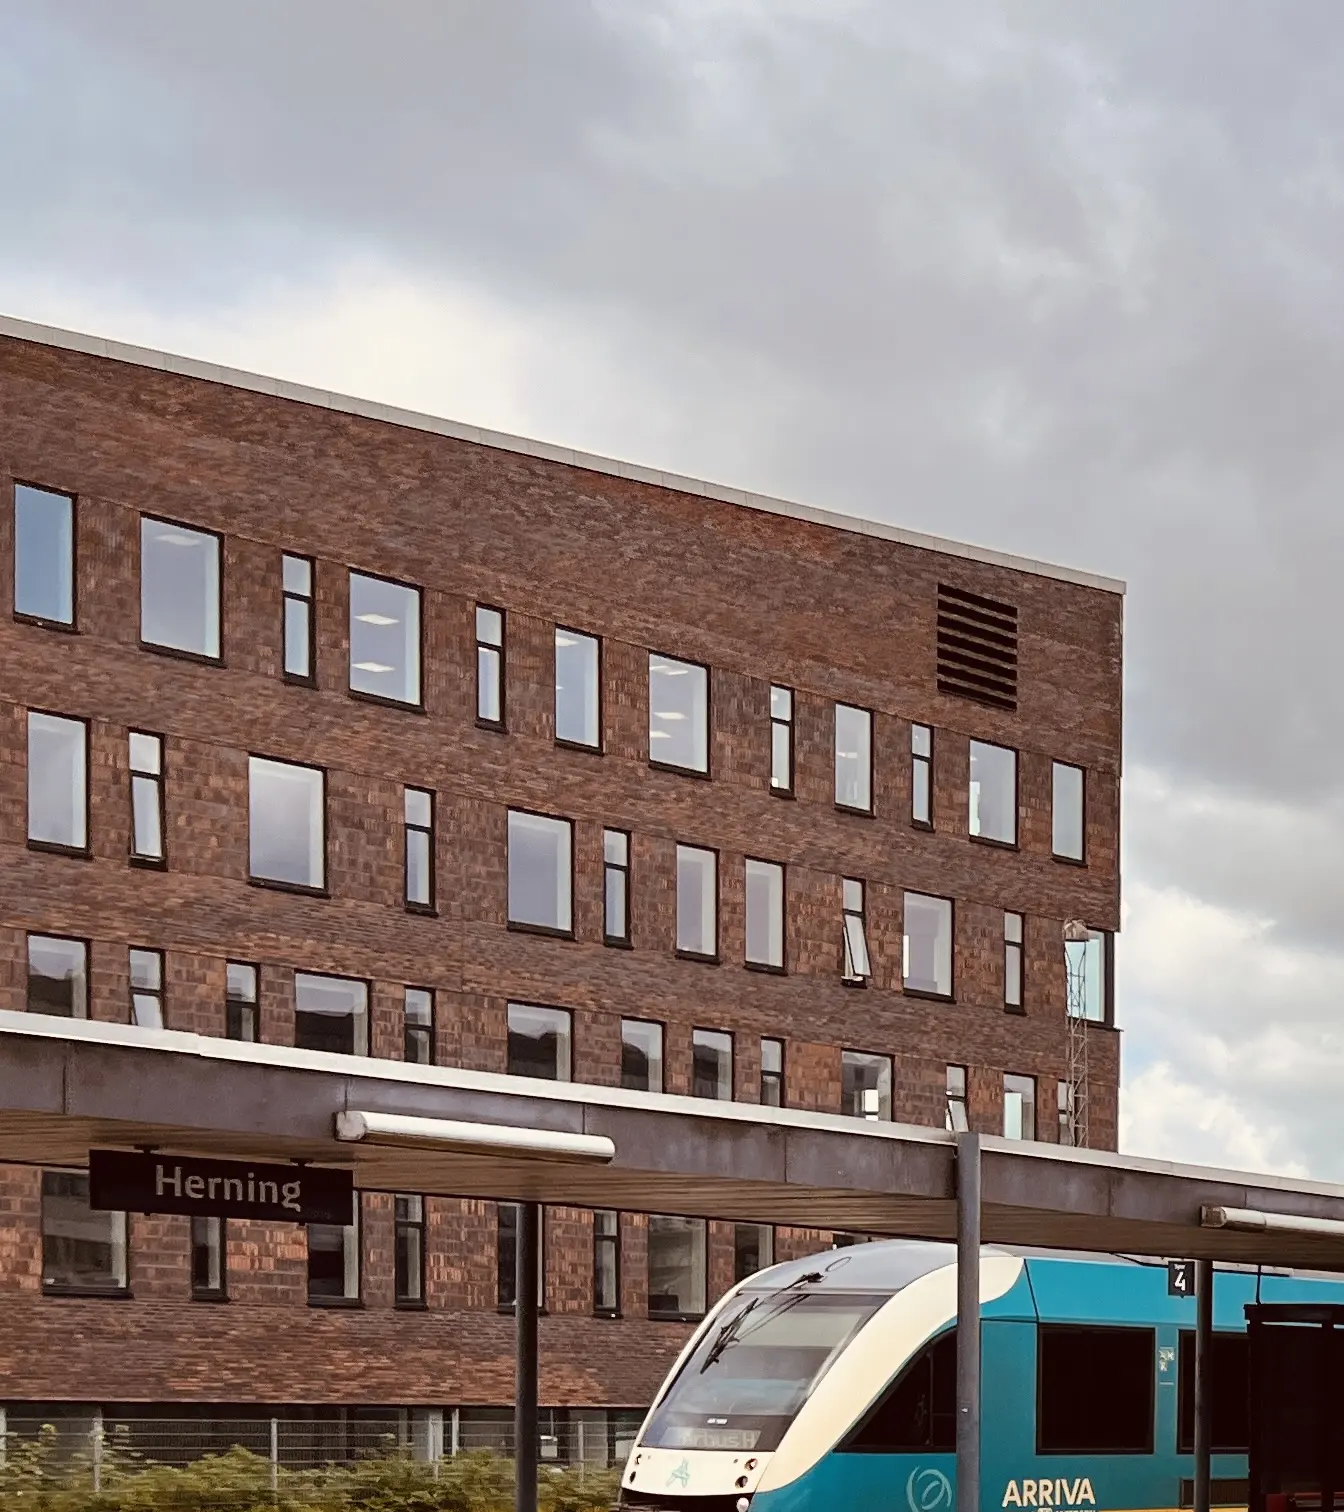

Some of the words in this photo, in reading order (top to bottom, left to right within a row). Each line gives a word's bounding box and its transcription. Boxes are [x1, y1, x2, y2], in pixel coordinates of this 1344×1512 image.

[155, 1164, 301, 1212] Herning
[1174, 1271, 1186, 1291] 4
[1001, 1478, 1096, 1507] ARRIVA
